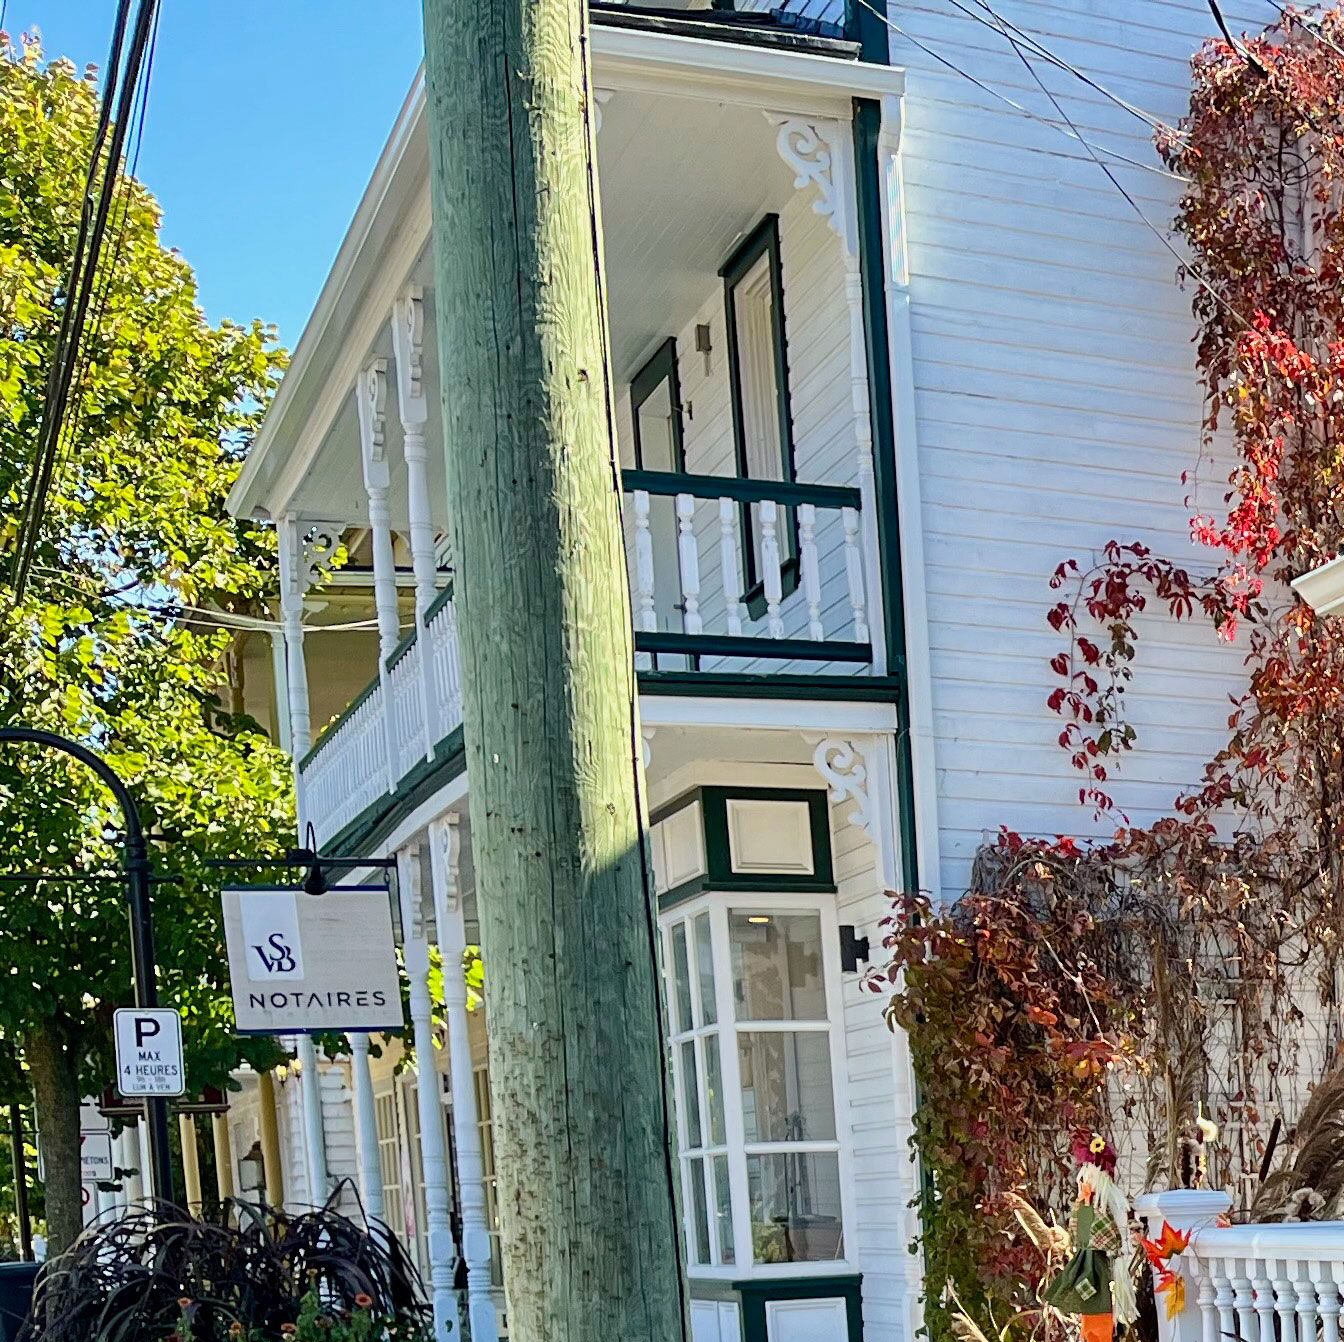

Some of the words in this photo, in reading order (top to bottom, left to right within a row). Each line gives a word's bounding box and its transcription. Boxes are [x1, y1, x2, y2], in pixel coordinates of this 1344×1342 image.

[249, 990, 386, 1010] NOTAIRES
[135, 1018, 160, 1048] P
[138, 1051, 161, 1061] MAX
[124, 1065, 131, 1075] 4
[136, 1064, 178, 1076] HEURES
